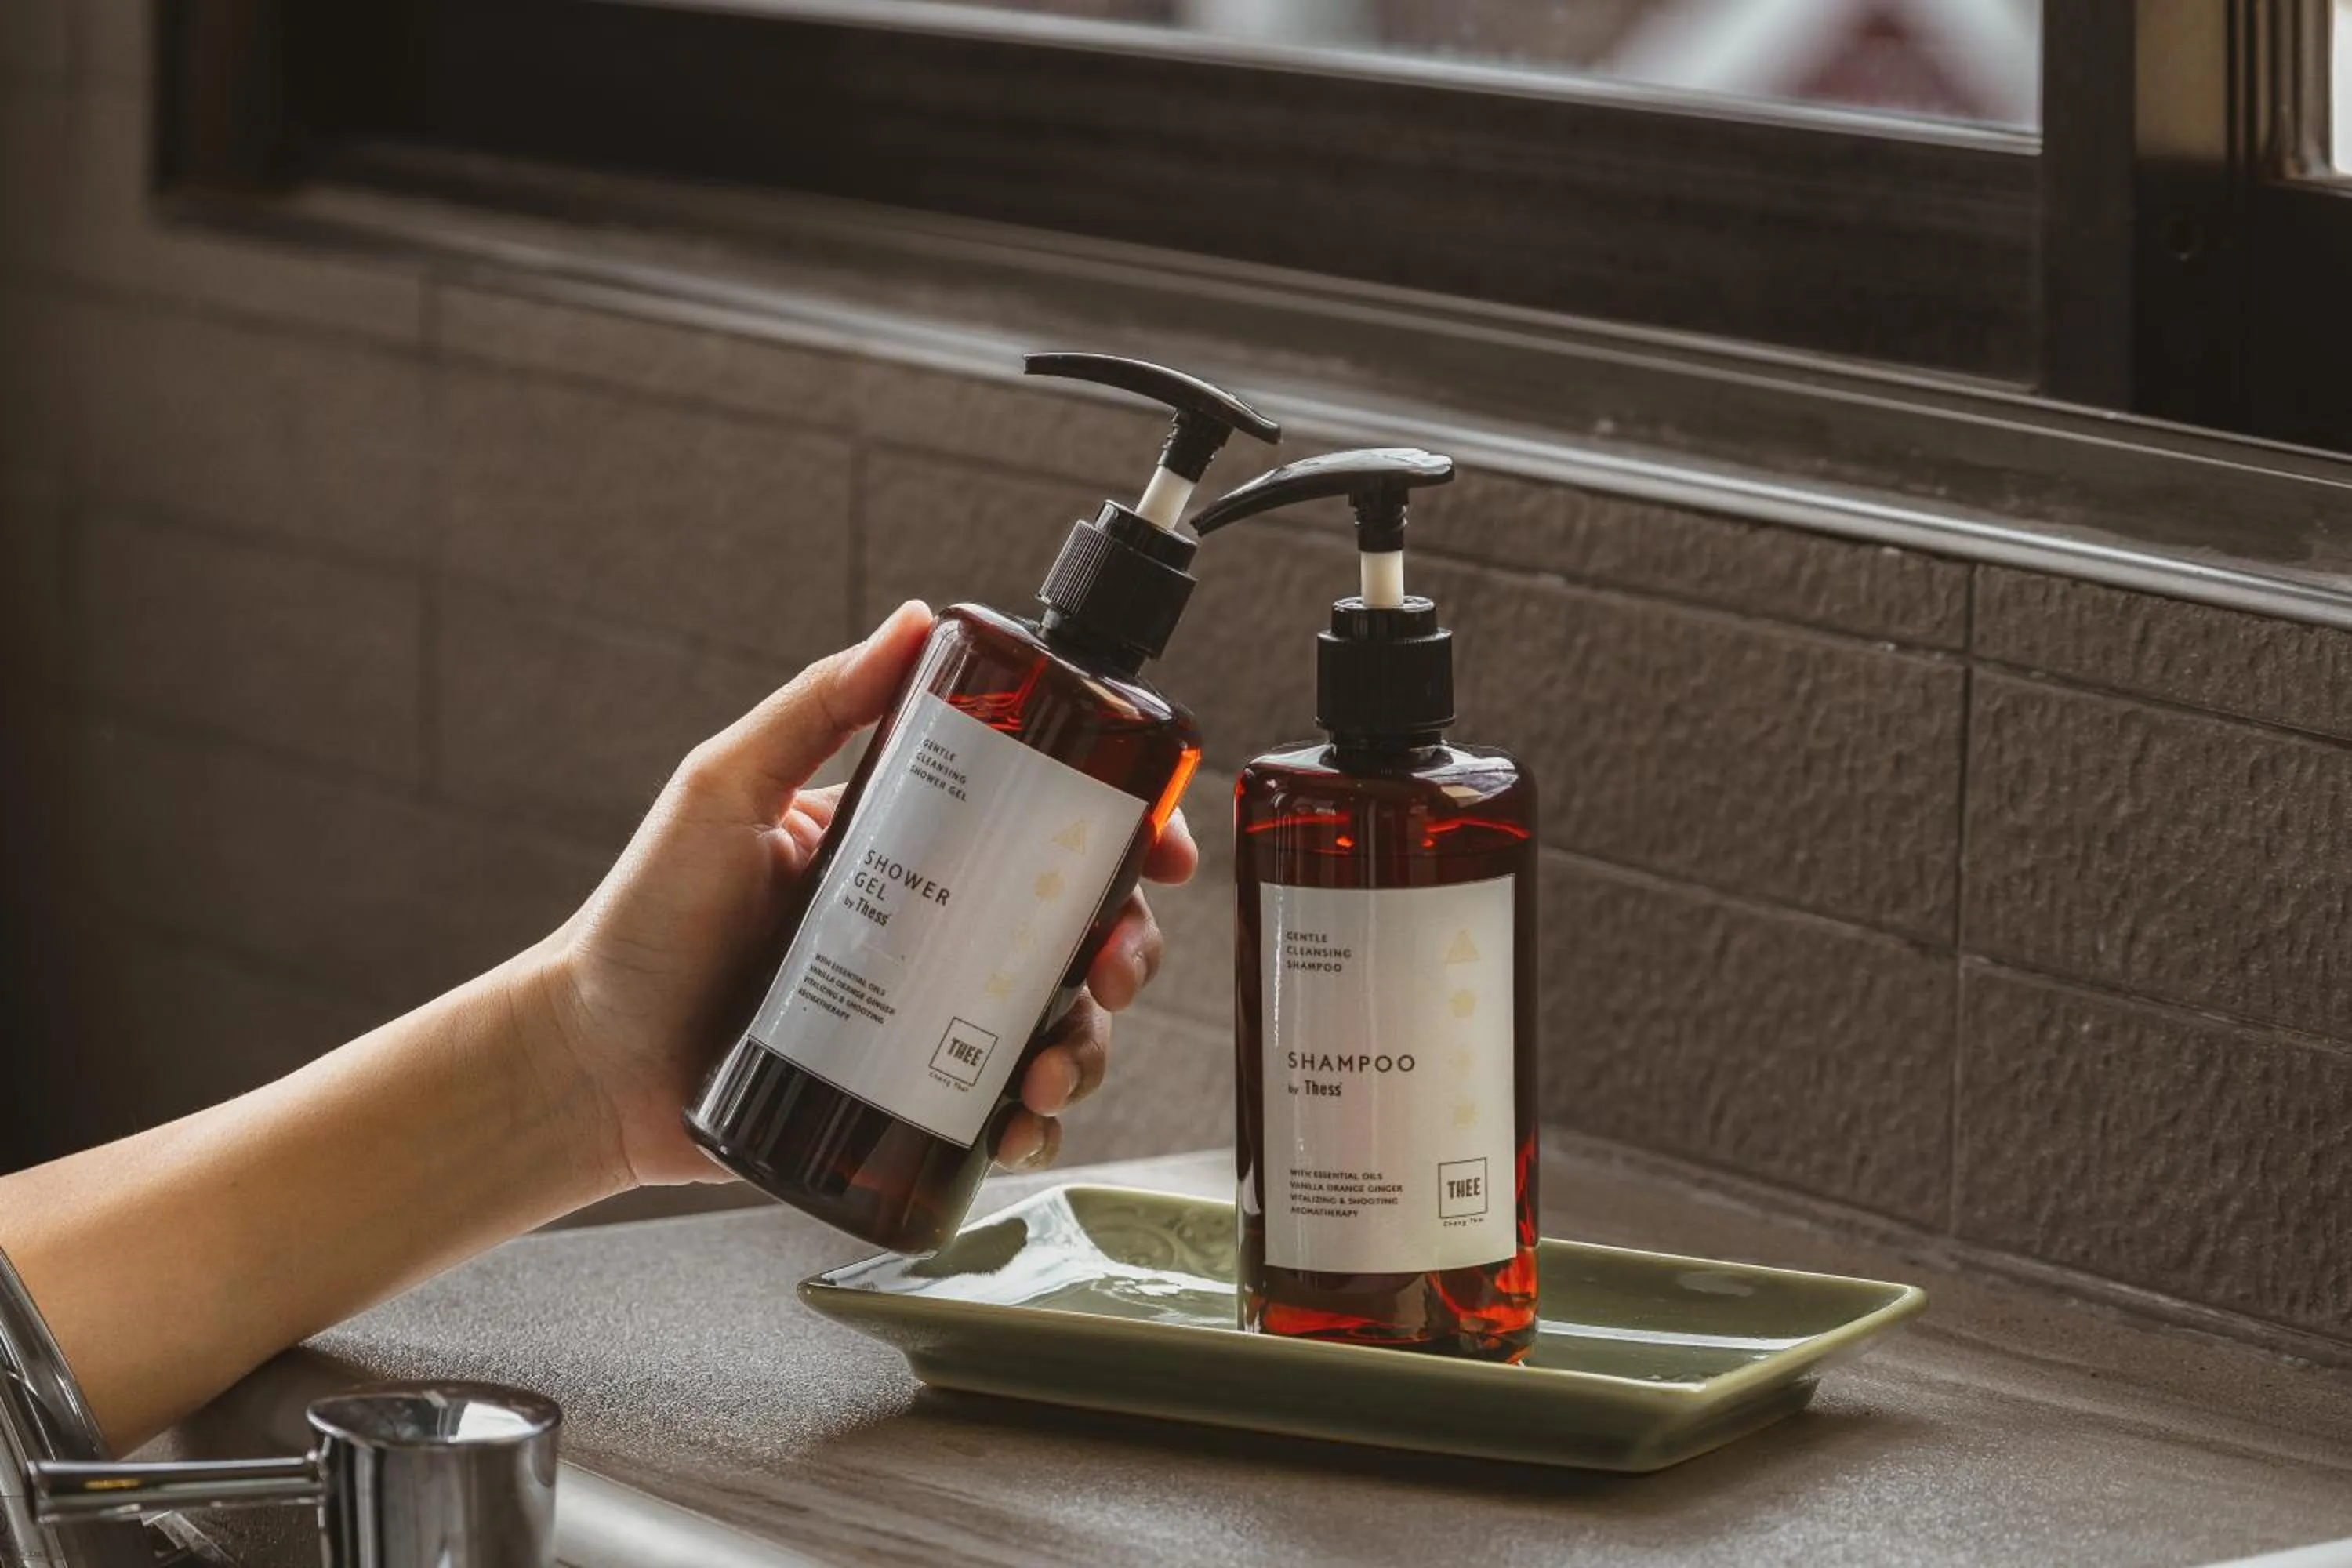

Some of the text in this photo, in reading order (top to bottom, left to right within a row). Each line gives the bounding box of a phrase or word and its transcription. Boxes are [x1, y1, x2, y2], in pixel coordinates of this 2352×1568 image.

[924, 739, 956, 762] GENTLE
[916, 752, 966, 784] CLEANSING
[910, 765, 966, 802] SHOWER GEL
[854, 871, 886, 901] GEL
[864, 849, 950, 907] SHOWER
[844, 896, 890, 927] by Thess
[1287, 931, 1327, 943] GENTLE
[1287, 945, 1352, 958] CLEANSING
[1287, 959, 1342, 972] SHAMPOO
[947, 1036, 984, 1067] THEE
[1288, 1051, 1415, 1073] SHAMPOO
[1288, 1080, 1342, 1097] by Thess
[1290, 1169, 1312, 1178] WITH
[1313, 1170, 1359, 1180] ESSENTIAL
[1290, 1181, 1324, 1191] VANILLA
[1327, 1184, 1365, 1192] ORANGE
[1447, 1177, 1481, 1199] THEE
[1290, 1206, 1359, 1217] AROMATHERAPY
